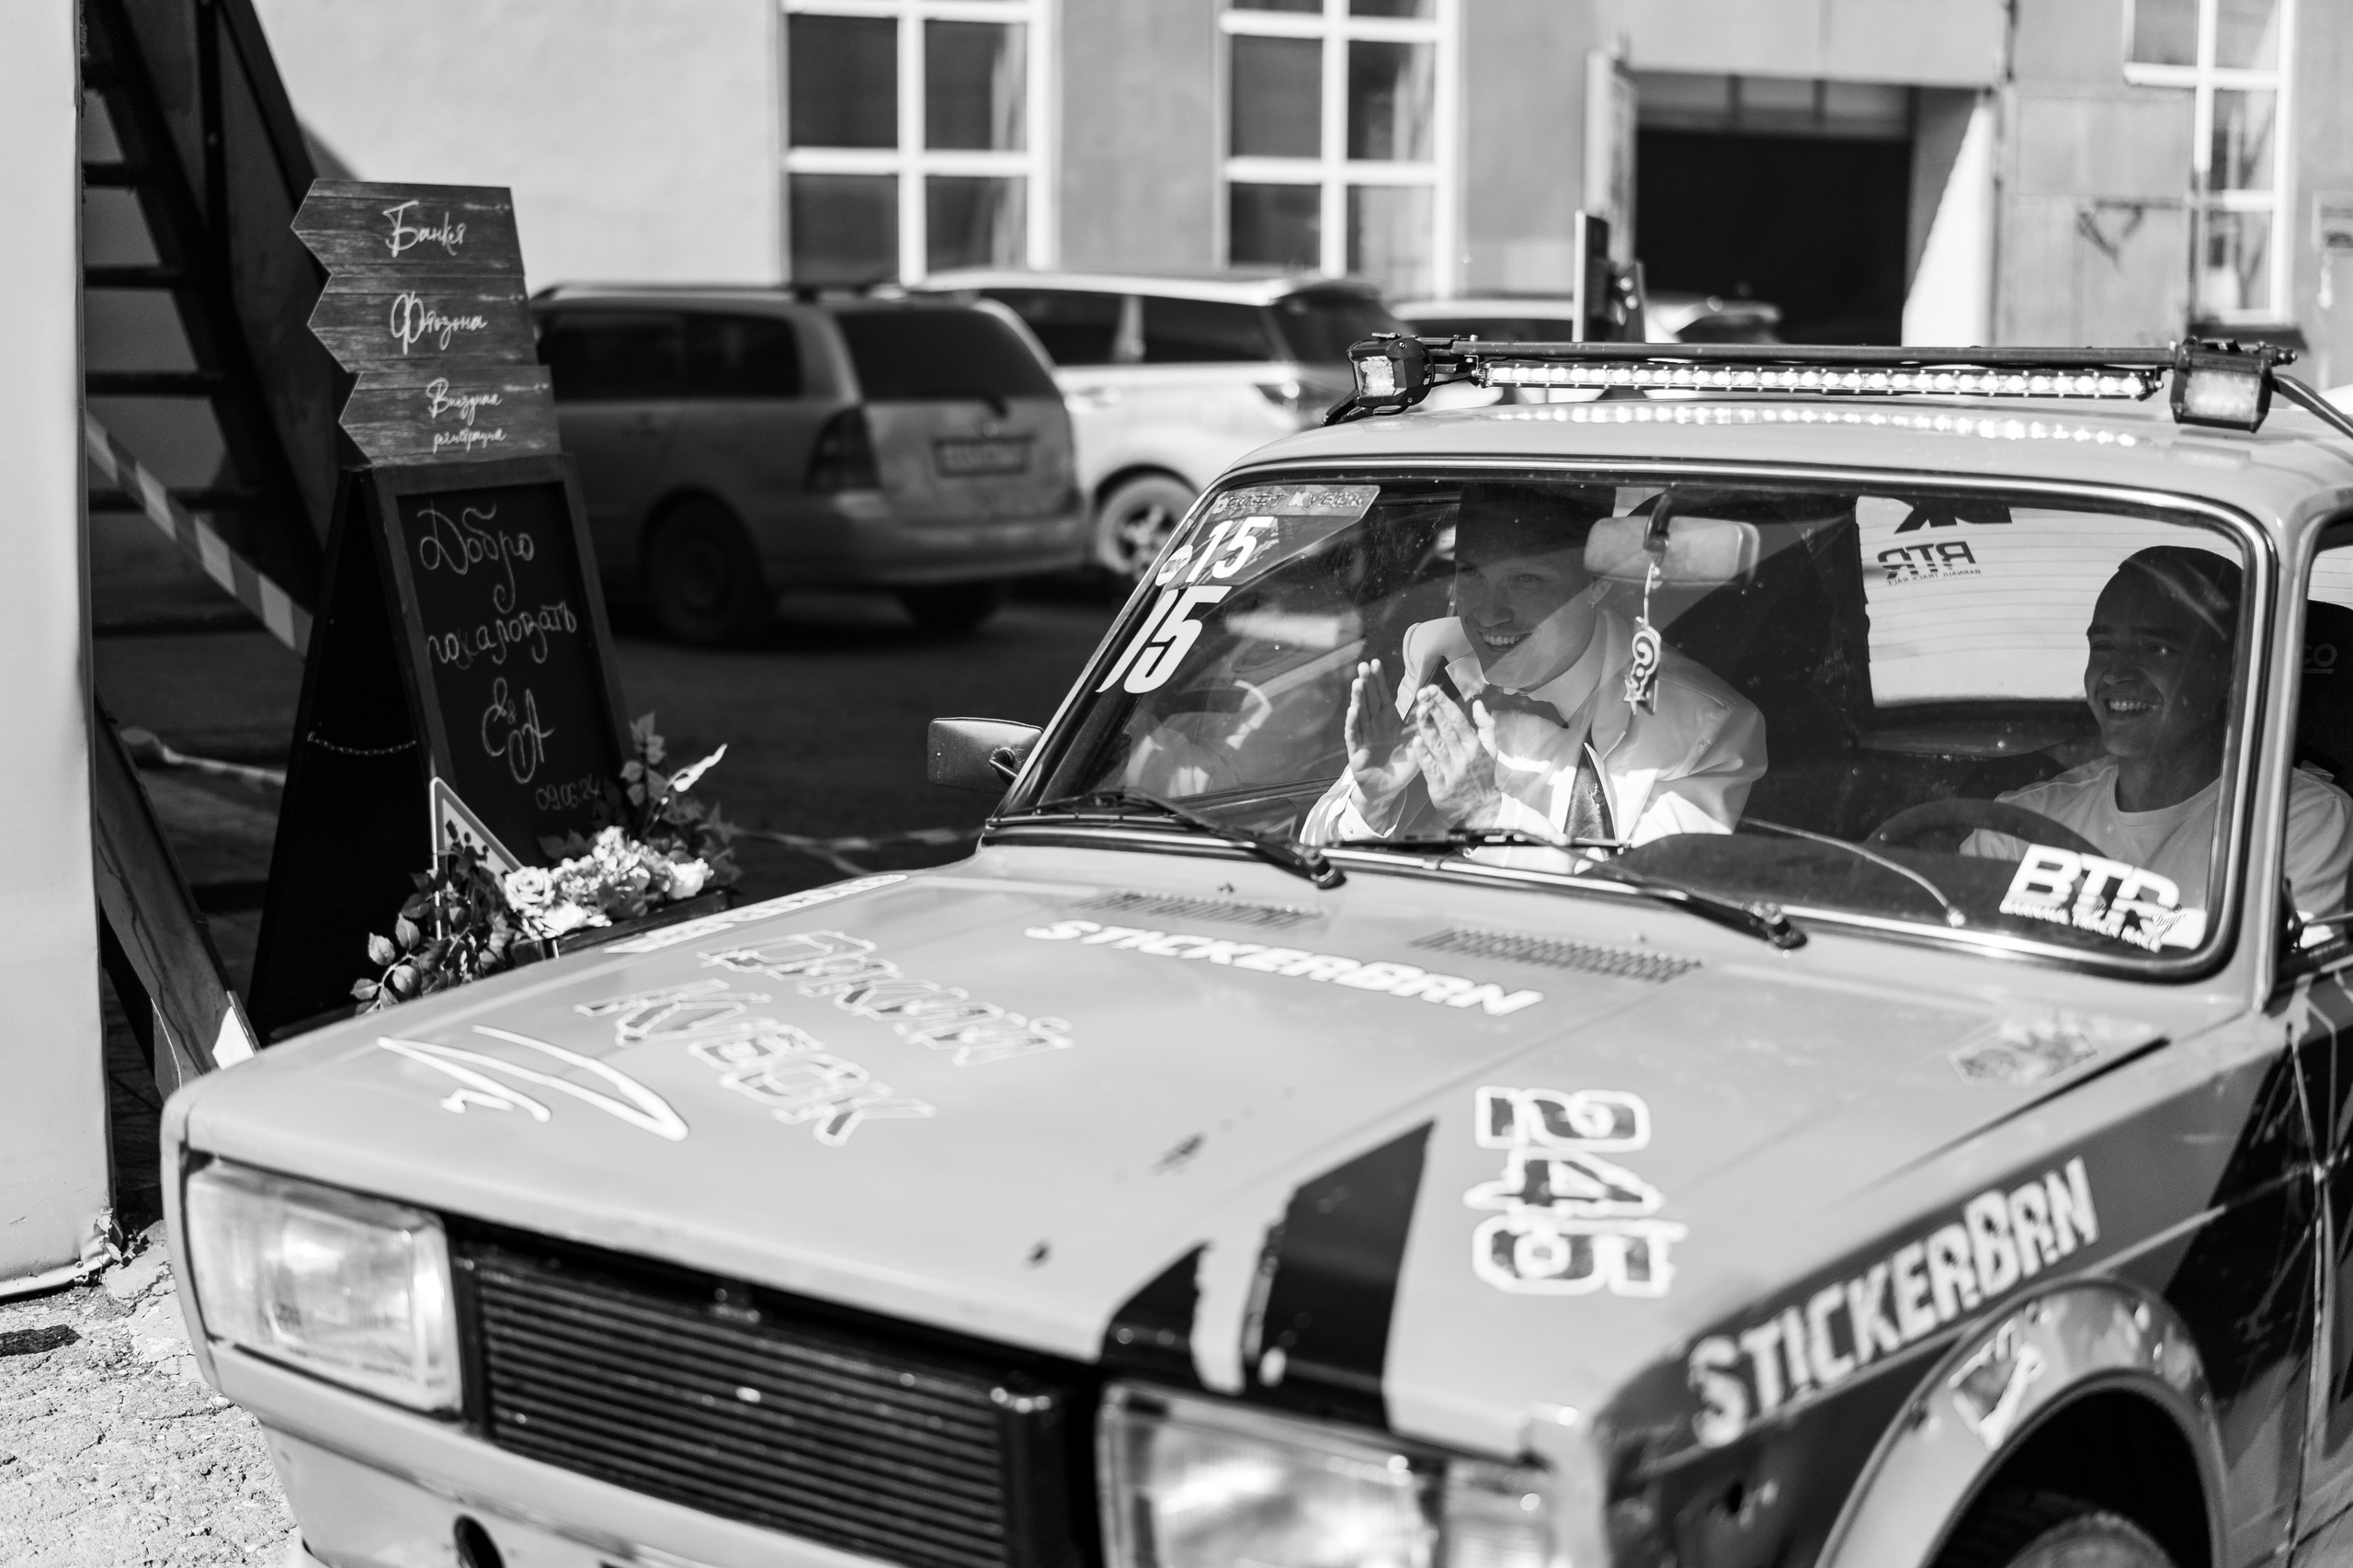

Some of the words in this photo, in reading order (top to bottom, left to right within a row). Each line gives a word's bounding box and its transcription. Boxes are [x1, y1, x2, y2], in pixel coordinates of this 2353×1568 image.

[416, 497, 534, 614] Добро
[1185, 516, 1275, 583] 15
[428, 600, 577, 670] пожаловать
[1095, 585, 1233, 694] 15
